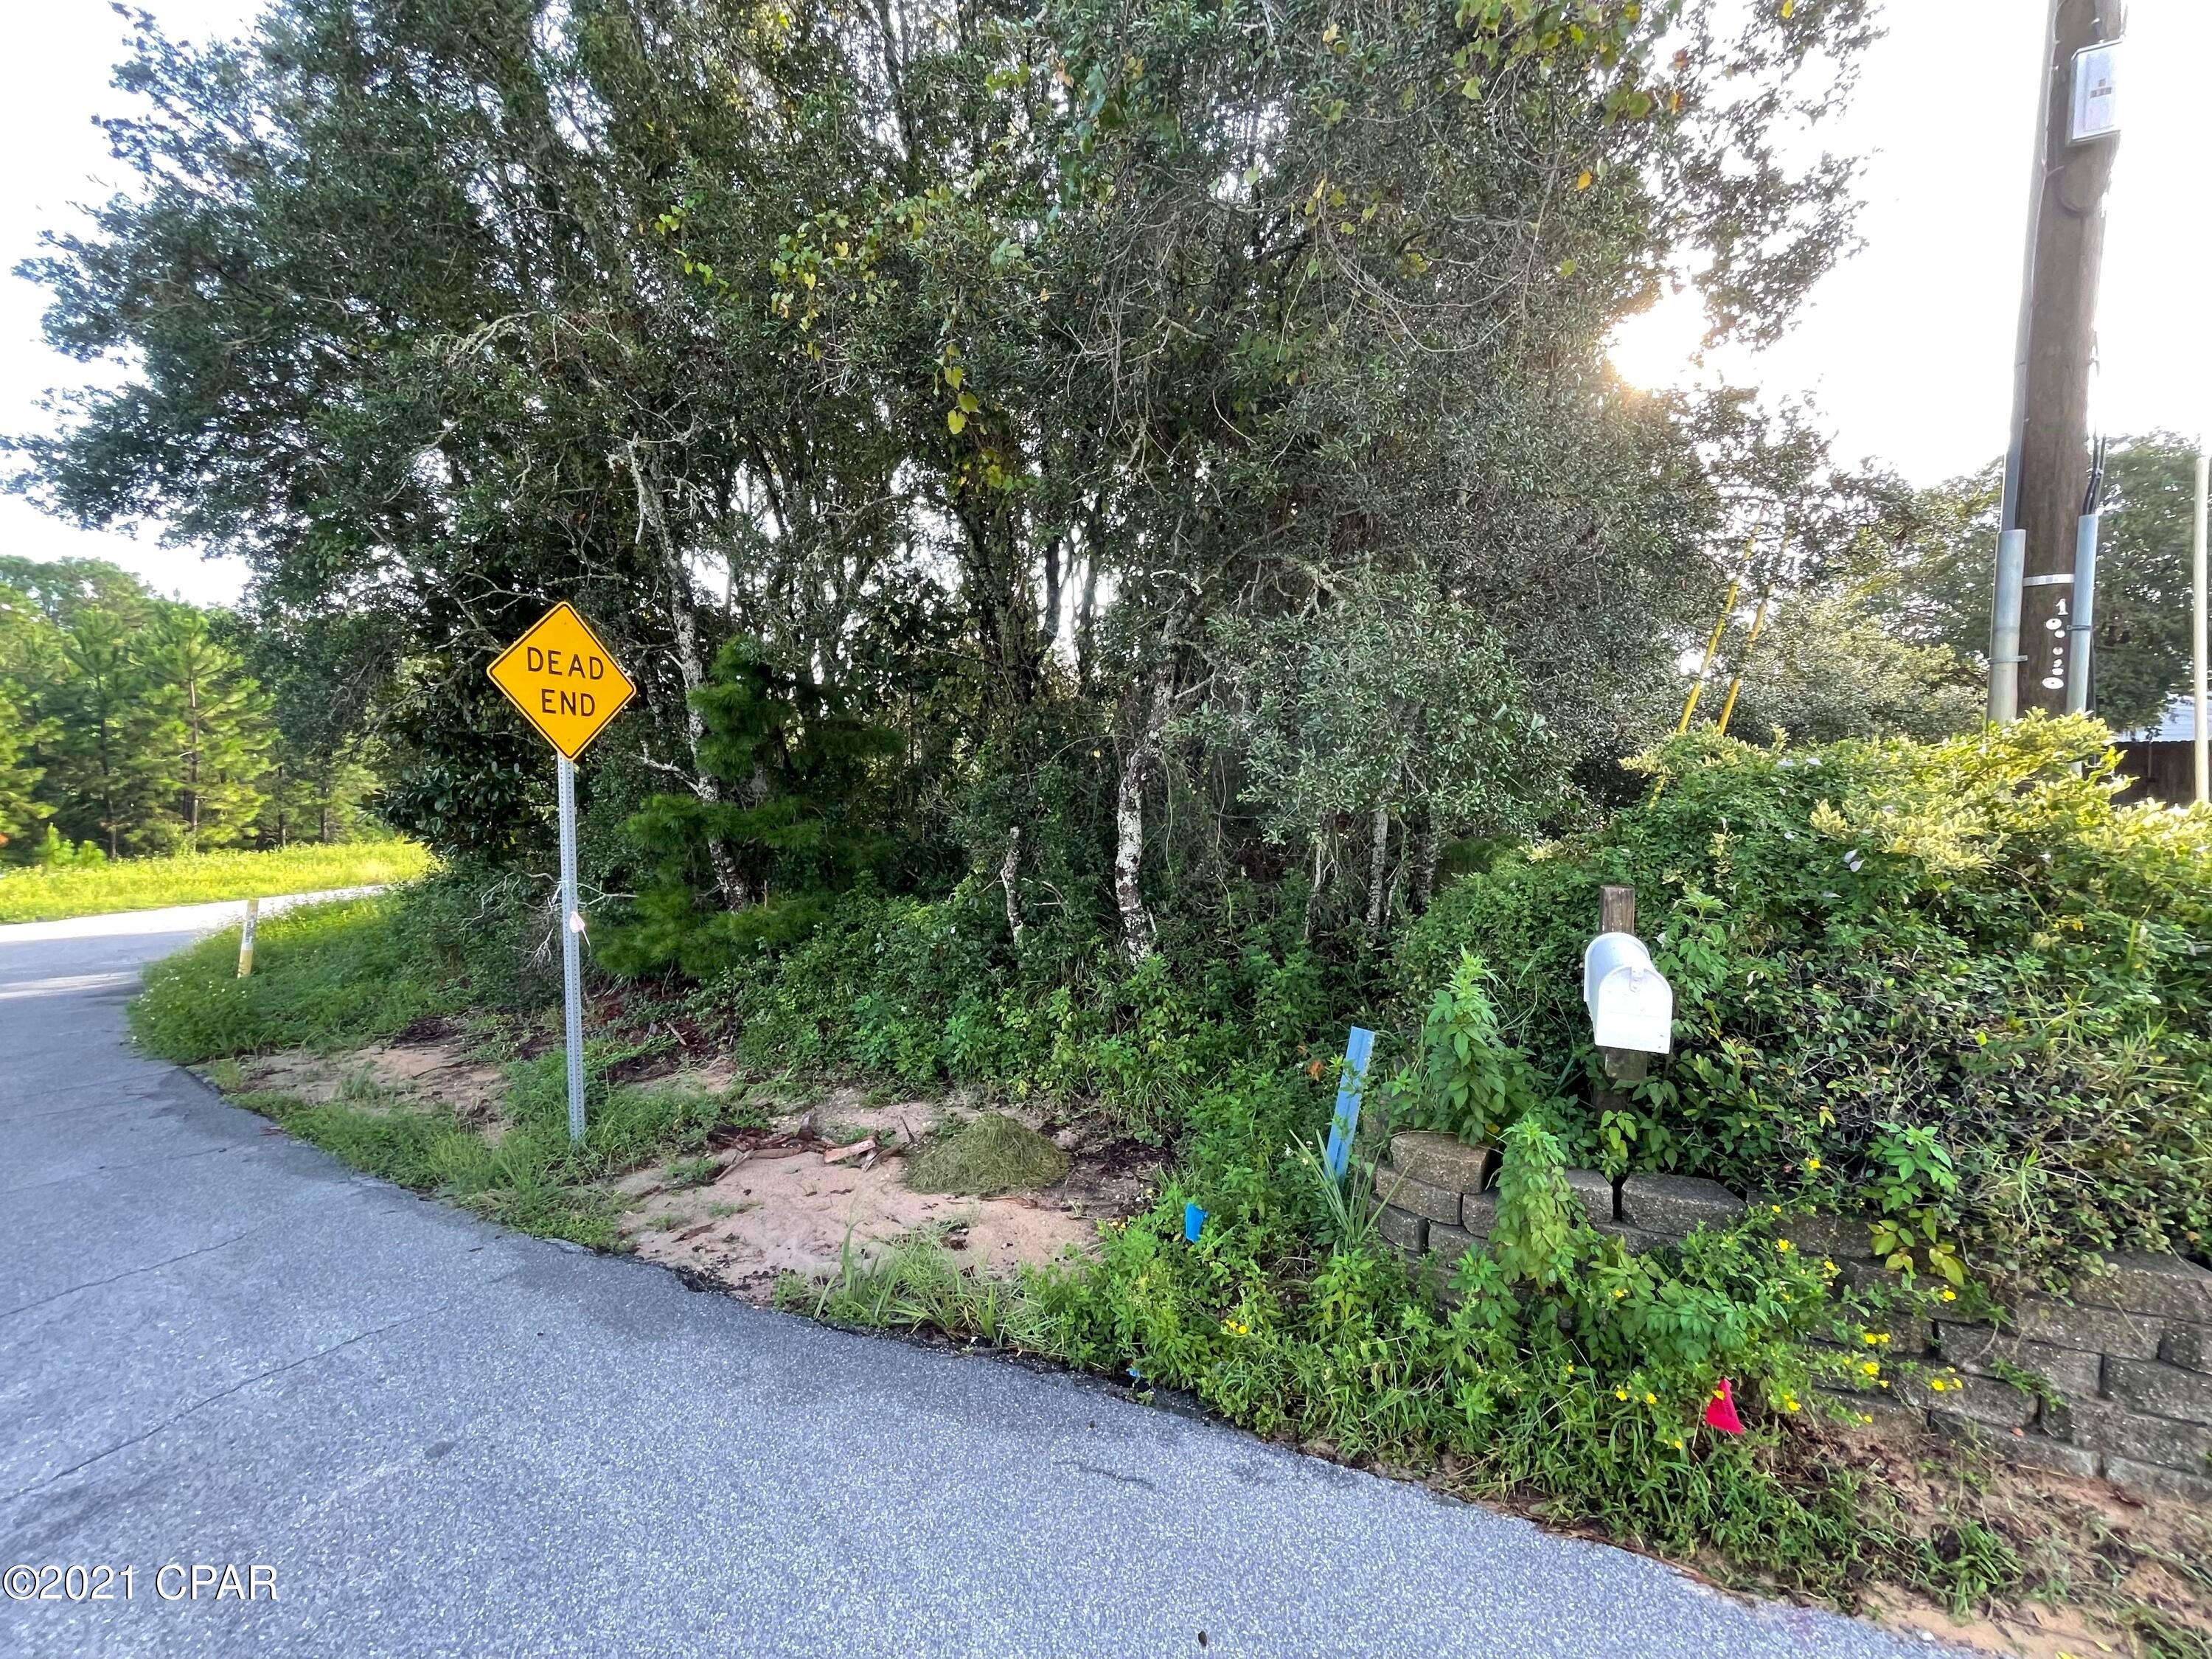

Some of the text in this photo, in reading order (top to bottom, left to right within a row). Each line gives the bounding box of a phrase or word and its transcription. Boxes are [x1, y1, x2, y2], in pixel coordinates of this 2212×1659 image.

[2056, 598, 2069, 615] 1
[527, 647, 604, 681] DEAD
[541, 688, 596, 717] END
